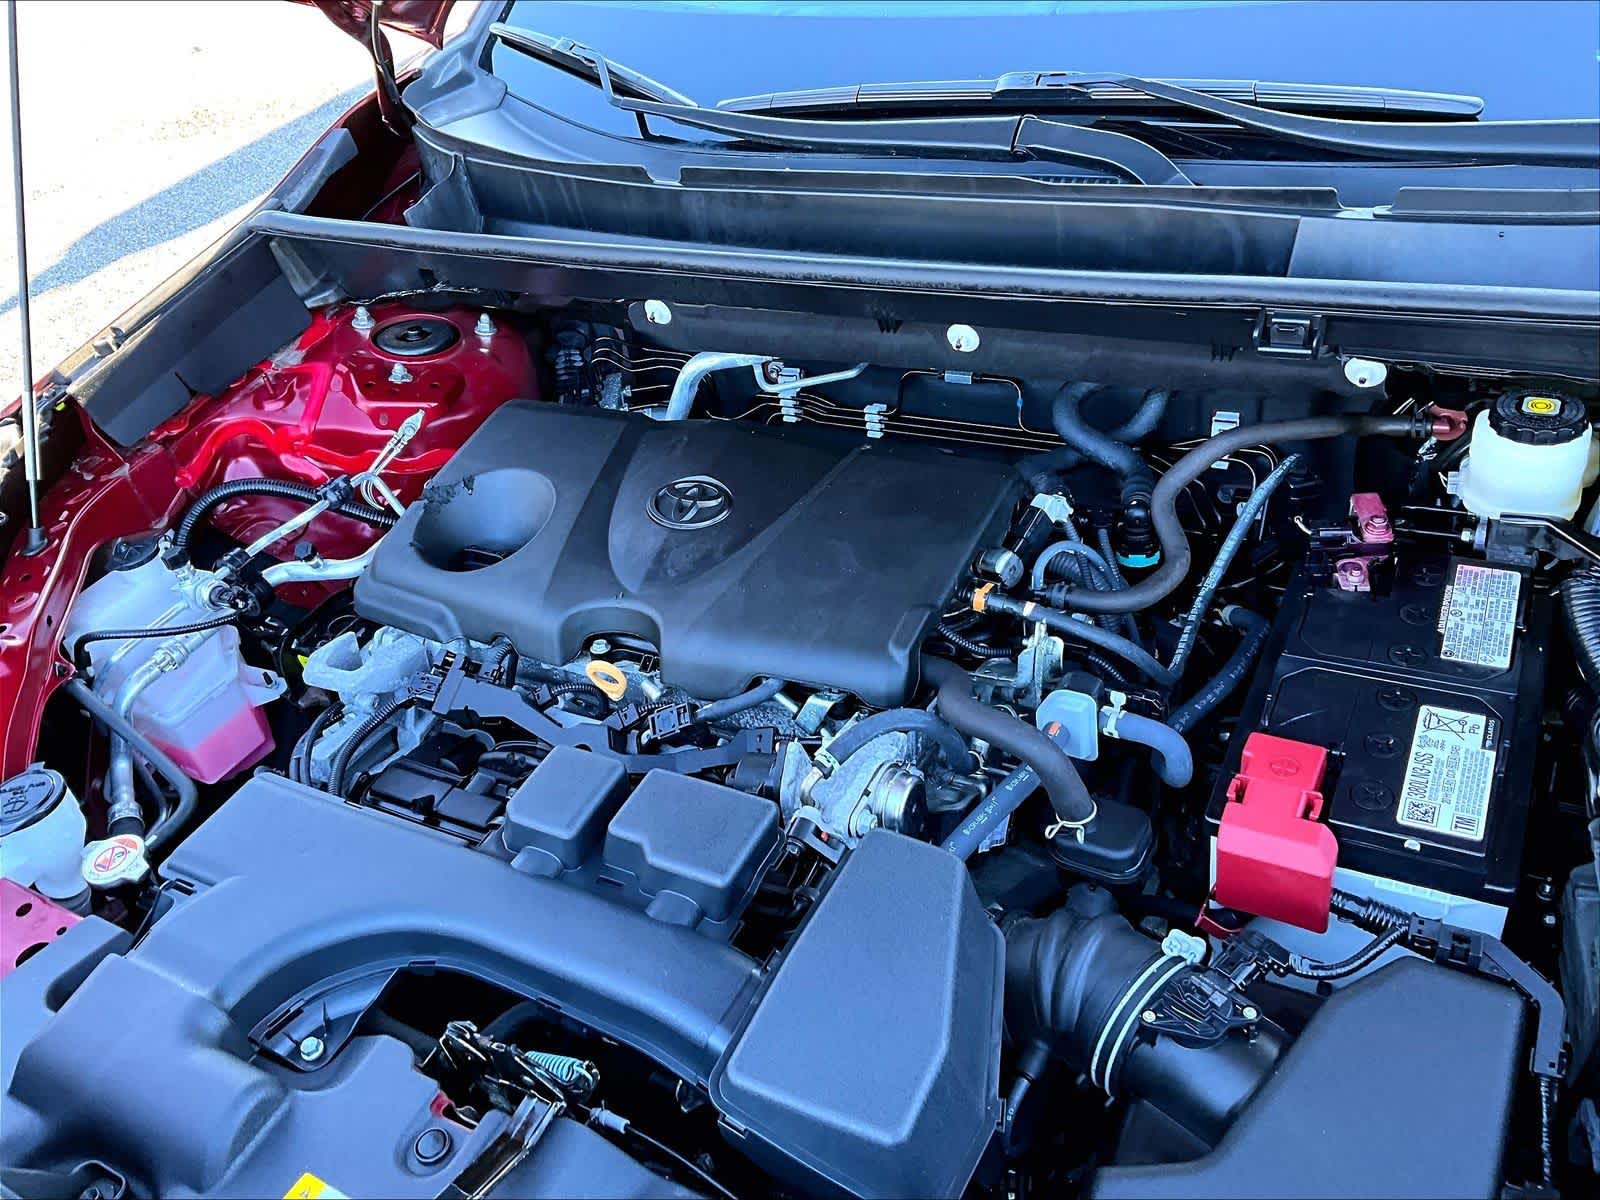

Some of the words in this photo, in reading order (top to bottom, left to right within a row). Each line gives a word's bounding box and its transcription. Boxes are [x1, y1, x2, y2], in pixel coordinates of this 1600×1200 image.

[1469, 724, 1480, 734] Pb
[1408, 752, 1434, 799] 380LN3-ISS
[1454, 816, 1476, 831] TM
